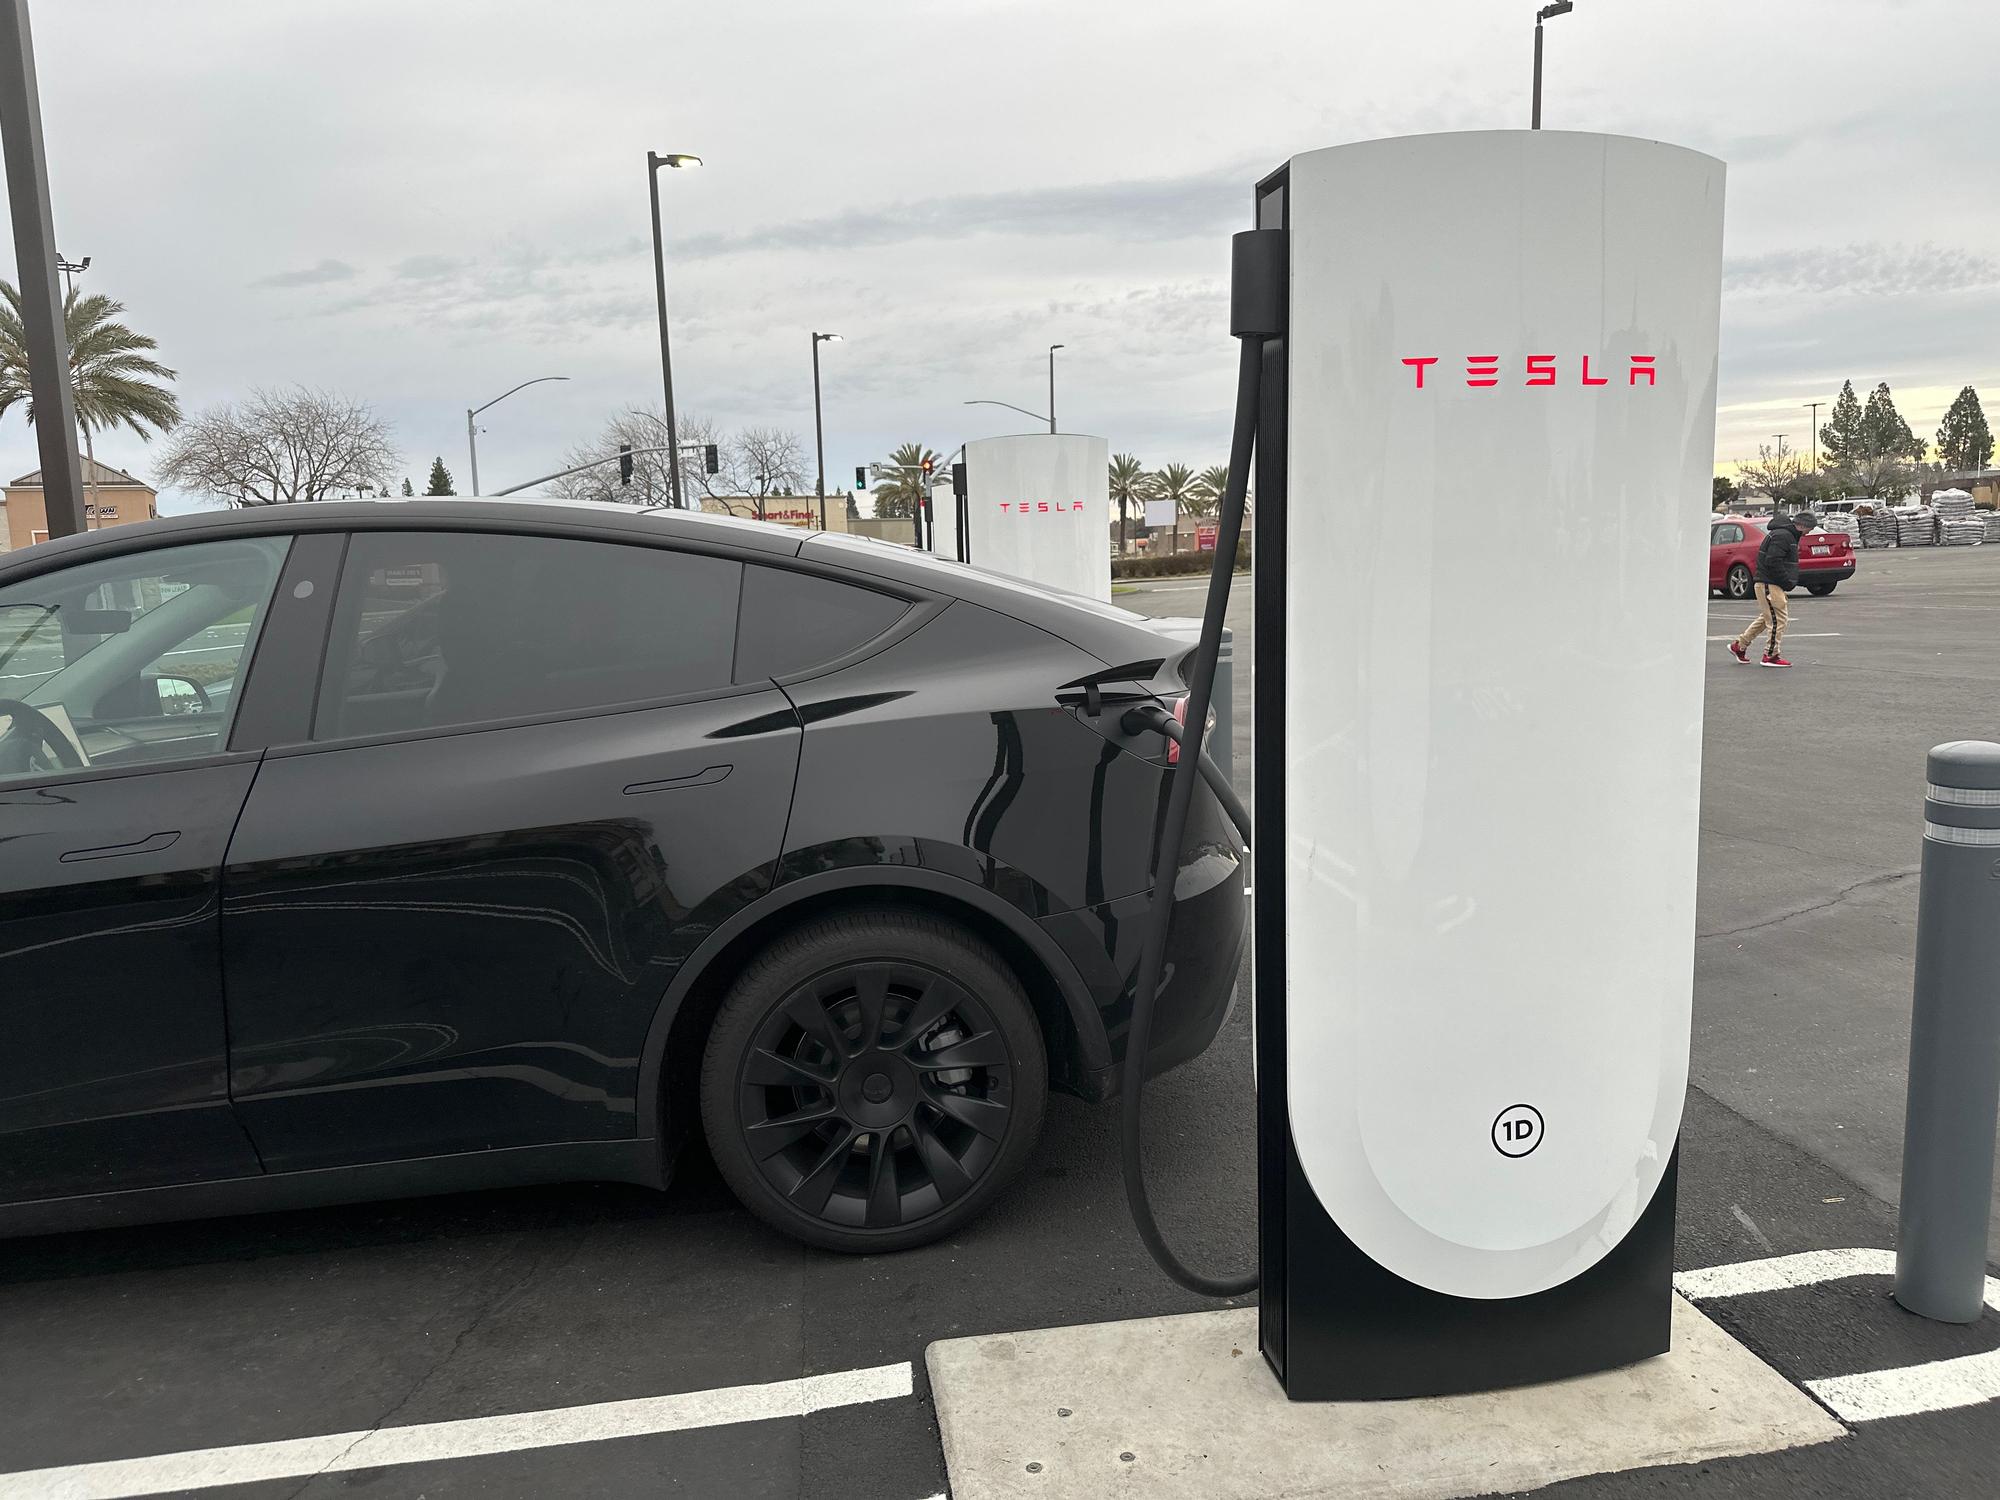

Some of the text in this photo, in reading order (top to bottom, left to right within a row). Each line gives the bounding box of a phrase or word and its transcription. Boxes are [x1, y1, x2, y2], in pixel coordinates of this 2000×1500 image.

[1401, 355, 1656, 388] TESLA
[999, 501, 1083, 513] TESLA
[1502, 1120, 1533, 1141] 1D
